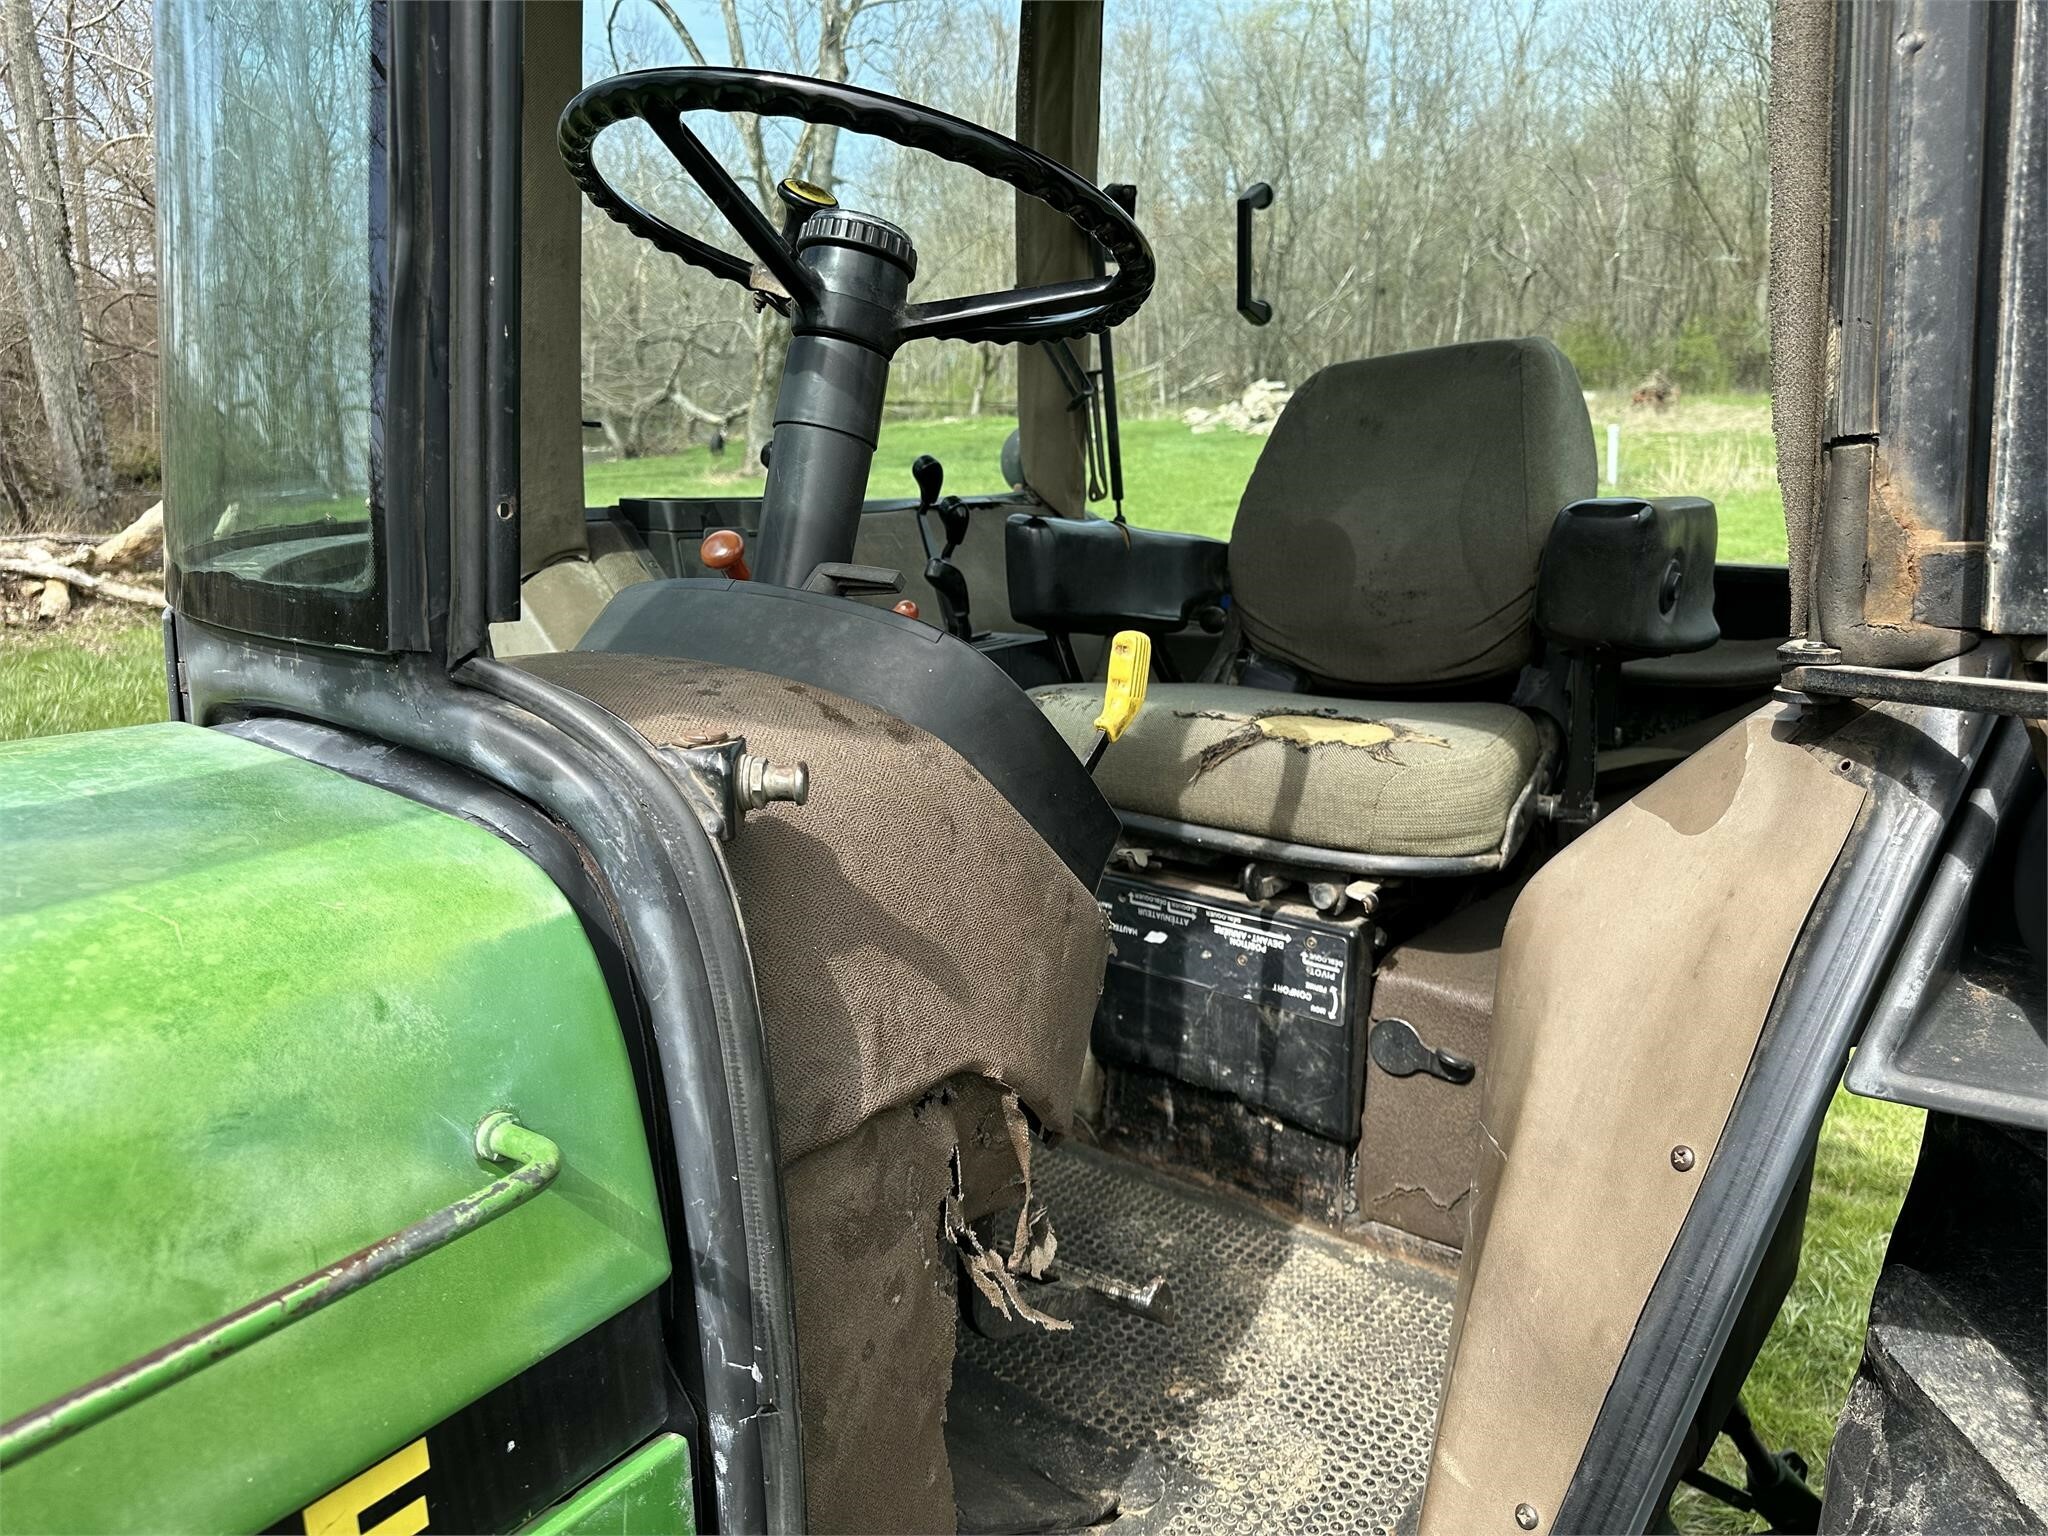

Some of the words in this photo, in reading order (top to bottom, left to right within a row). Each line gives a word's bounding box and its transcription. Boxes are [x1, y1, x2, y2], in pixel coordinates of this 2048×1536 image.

[1137, 908, 1189, 926] ATTÉNUATEUR
[1229, 937, 1267, 954] POSITION
[1251, 934, 1285, 950] DEVANT
[1272, 983, 1313, 1002] CONFORT
